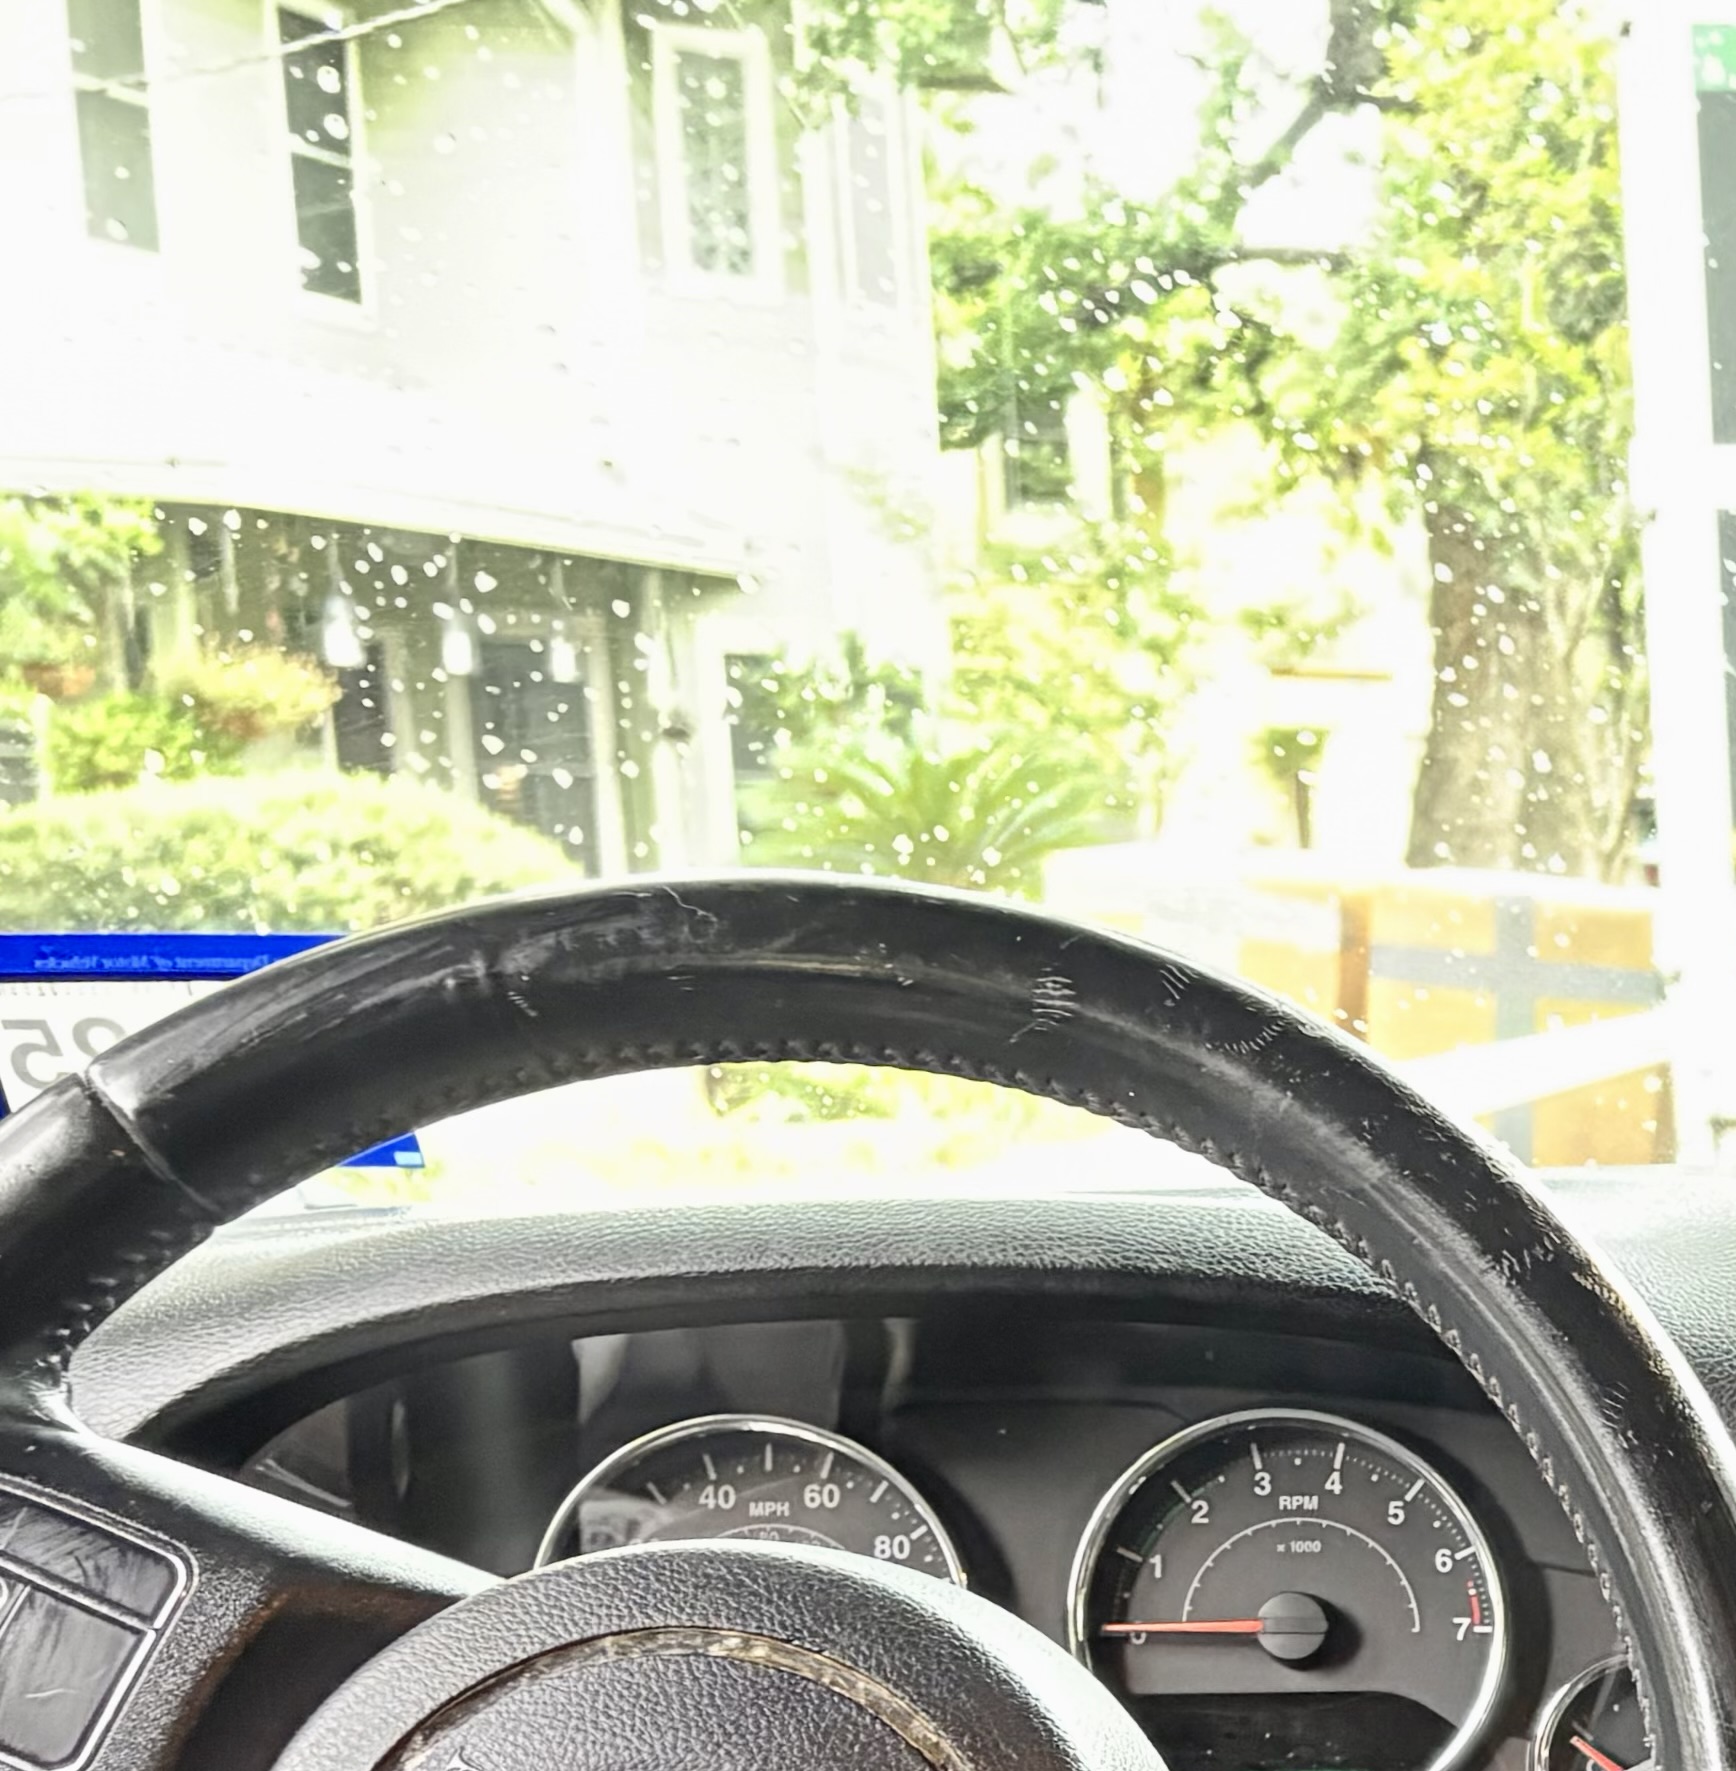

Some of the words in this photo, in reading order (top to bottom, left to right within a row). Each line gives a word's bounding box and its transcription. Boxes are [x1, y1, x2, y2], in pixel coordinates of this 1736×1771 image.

[1254, 1472, 1271, 1496] 3
[1324, 1471, 1344, 1495] 4
[699, 1484, 736, 1511] 40
[804, 1483, 841, 1510] 60
[1279, 1495, 1319, 1511] RPM
[749, 1500, 789, 1518] MPH
[1191, 1500, 1210, 1525] 2
[1387, 1501, 1405, 1525] 5
[873, 1535, 911, 1561] 80
[1290, 1540, 1321, 1553] 1000
[1149, 1555, 1163, 1578] 1
[1434, 1549, 1453, 1572] 6
[1452, 1618, 1470, 1641] 7
